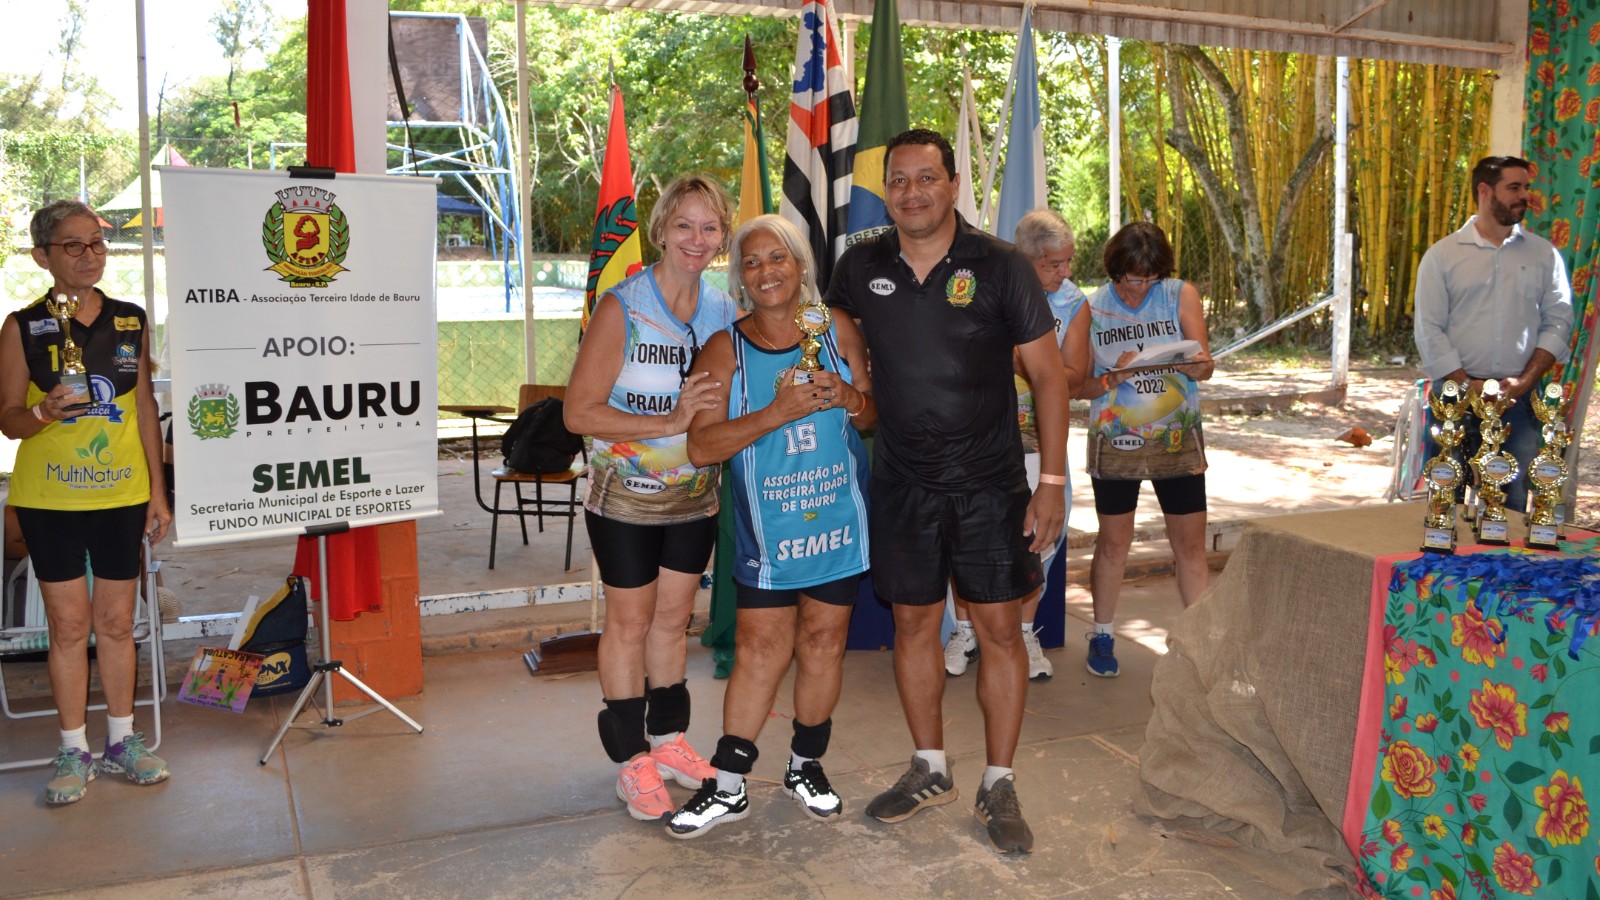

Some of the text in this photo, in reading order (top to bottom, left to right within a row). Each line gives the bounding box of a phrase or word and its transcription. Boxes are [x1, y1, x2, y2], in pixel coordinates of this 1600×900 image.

[185, 289, 240, 304] ATIBA
[251, 293, 306, 305] Associação
[310, 293, 347, 302] Terceira
[350, 293, 376, 302] Idade
[379, 293, 391, 302] de
[393, 293, 420, 302] Bauru
[262, 335, 355, 358] APOIO:
[1096, 323, 1145, 347] TORNEIO
[1134, 379, 1167, 395] 2022
[245, 380, 420, 425] BAURU
[626, 392, 672, 413] PRAIA
[246, 421, 421, 438] PREFEITURA
[784, 421, 818, 456] 15
[1112, 439, 1144, 447] SEMEL
[46, 462, 132, 483] MultiNature
[252, 456, 371, 494] SEMEL
[764, 462, 844, 487] ASSOCIAÇÃO DA
[625, 479, 664, 491] SEMEL
[762, 474, 848, 501] TERCEIRA IDADE
[191, 483, 425, 516] Secretaria Municipal de Esporte e Lazer
[781, 492, 836, 513] DE BAURU
[209, 500, 412, 532] FUNDO MUNICIPAL DE ESPORTES
[776, 525, 853, 561] SEMEL
